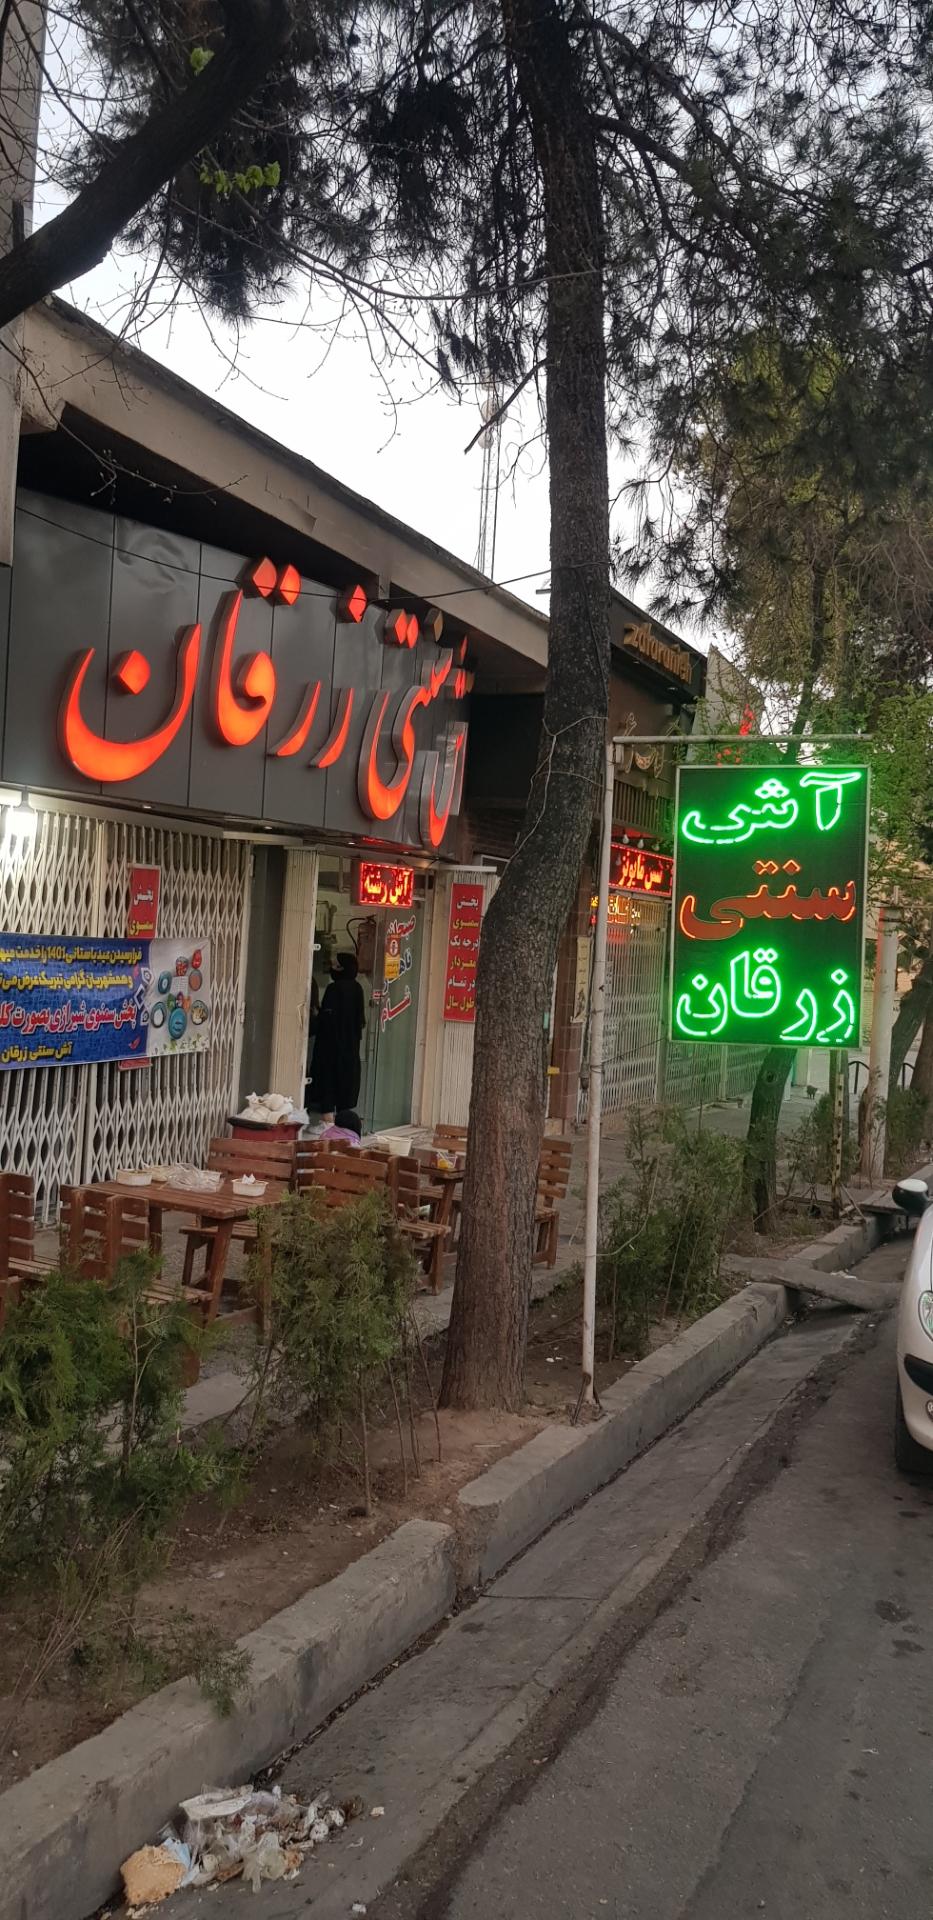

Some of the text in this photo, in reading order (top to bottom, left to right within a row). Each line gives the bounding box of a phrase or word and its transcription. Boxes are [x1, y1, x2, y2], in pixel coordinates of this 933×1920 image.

[58, 556, 366, 783] زرقان
[357, 608, 453, 821] سنتی
[364, 871, 411, 904] آش رشته
[680, 858, 856, 940] سنتی
[676, 947, 855, 1042] زرقان
[1, 1040, 72, 1063] آش سنتی زرقان
